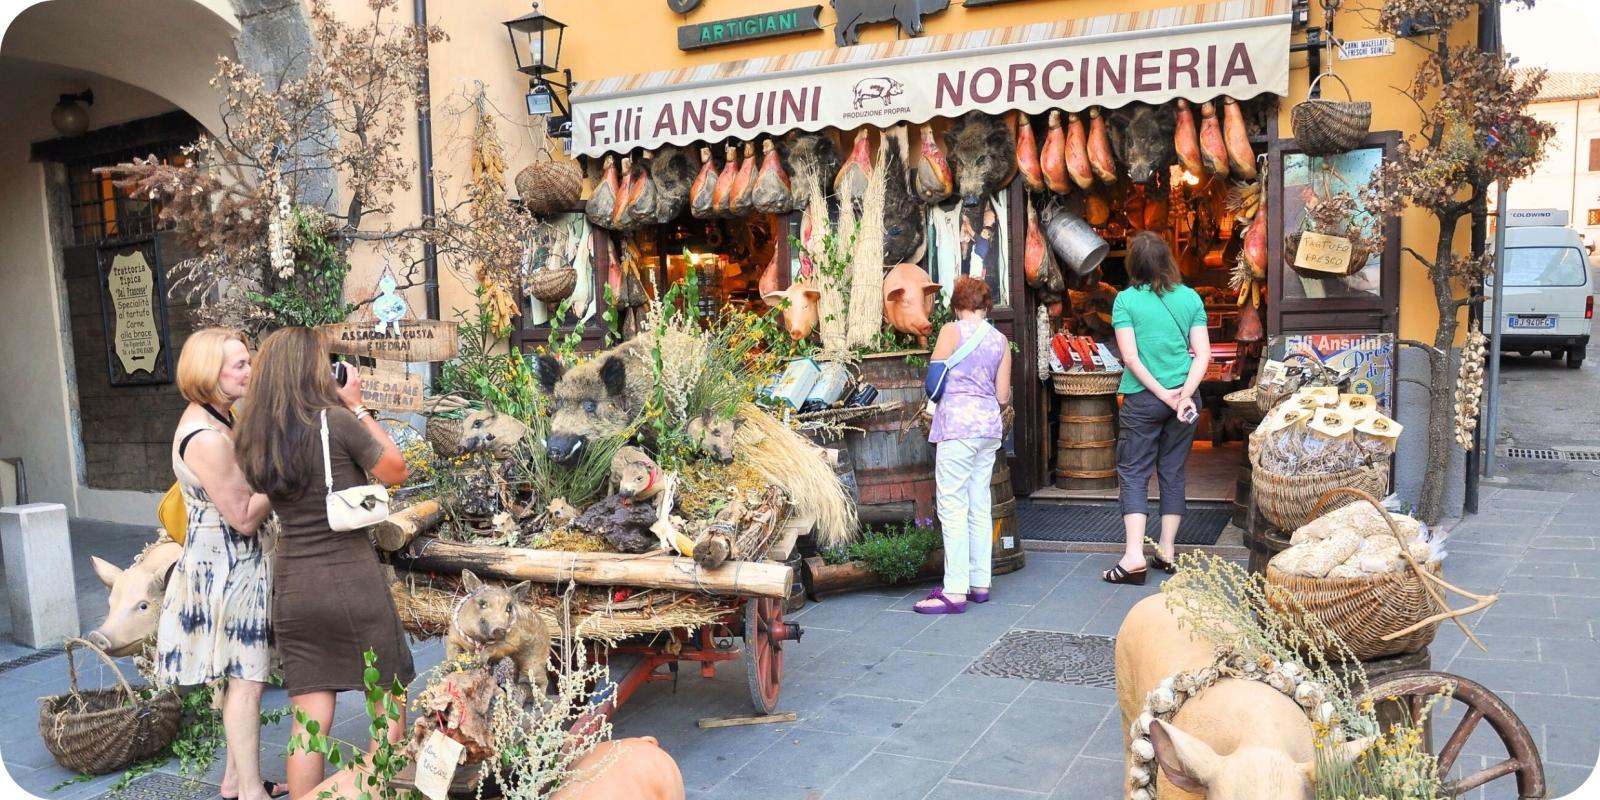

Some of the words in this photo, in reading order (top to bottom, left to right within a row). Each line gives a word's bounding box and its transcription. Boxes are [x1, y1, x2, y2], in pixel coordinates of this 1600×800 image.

[700, 13, 798, 42] ARTIGIANI
[935, 42, 1258, 109] NORCINERIA
[589, 106, 643, 147] F.lli
[652, 86, 822, 138] ANSUINI
[842, 109, 882, 119] PRODUZIONE
[883, 106, 911, 116] PROPRIA
[114, 265, 145, 276] Trattoria
[119, 276, 142, 287] Tipica
[126, 310, 149, 318] tartufo
[133, 329, 152, 338] brace
[402, 329, 434, 340] GUSTA
[1318, 335, 1381, 351] Ansuini
